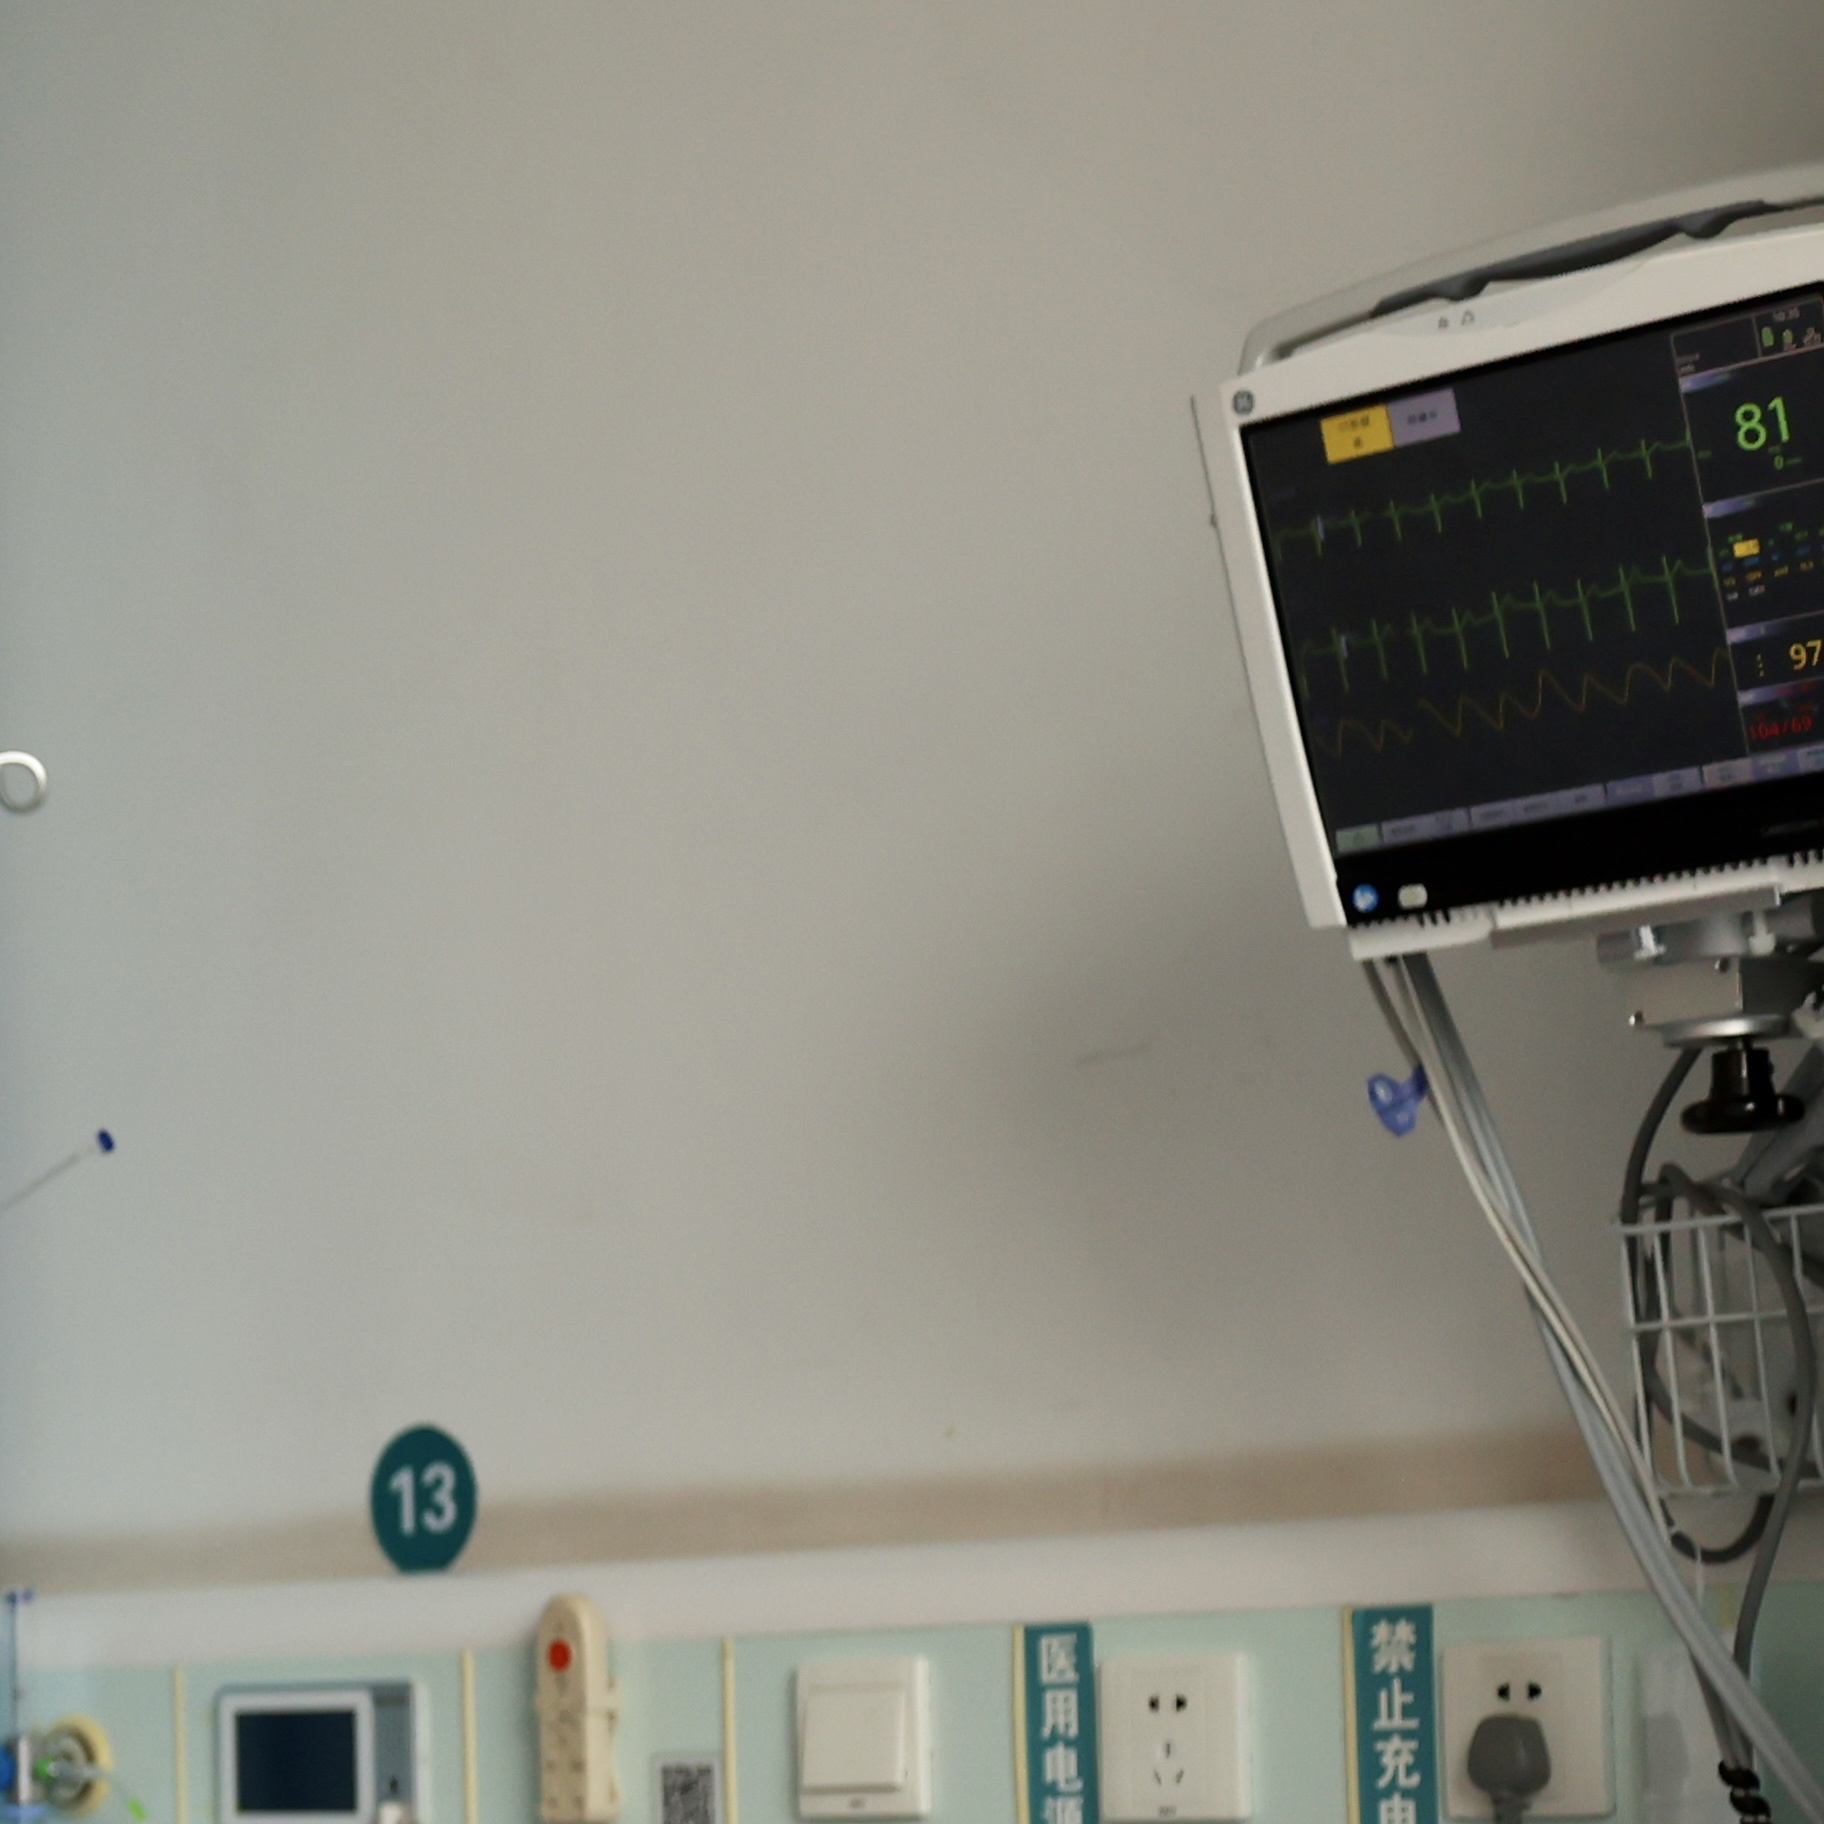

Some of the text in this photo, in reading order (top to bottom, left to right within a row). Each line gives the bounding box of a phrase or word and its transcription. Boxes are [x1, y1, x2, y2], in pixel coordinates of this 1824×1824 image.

[1734, 396, 1790, 451] 81
[1789, 639, 1823, 670] 97
[388, 1461, 458, 1537] 13
